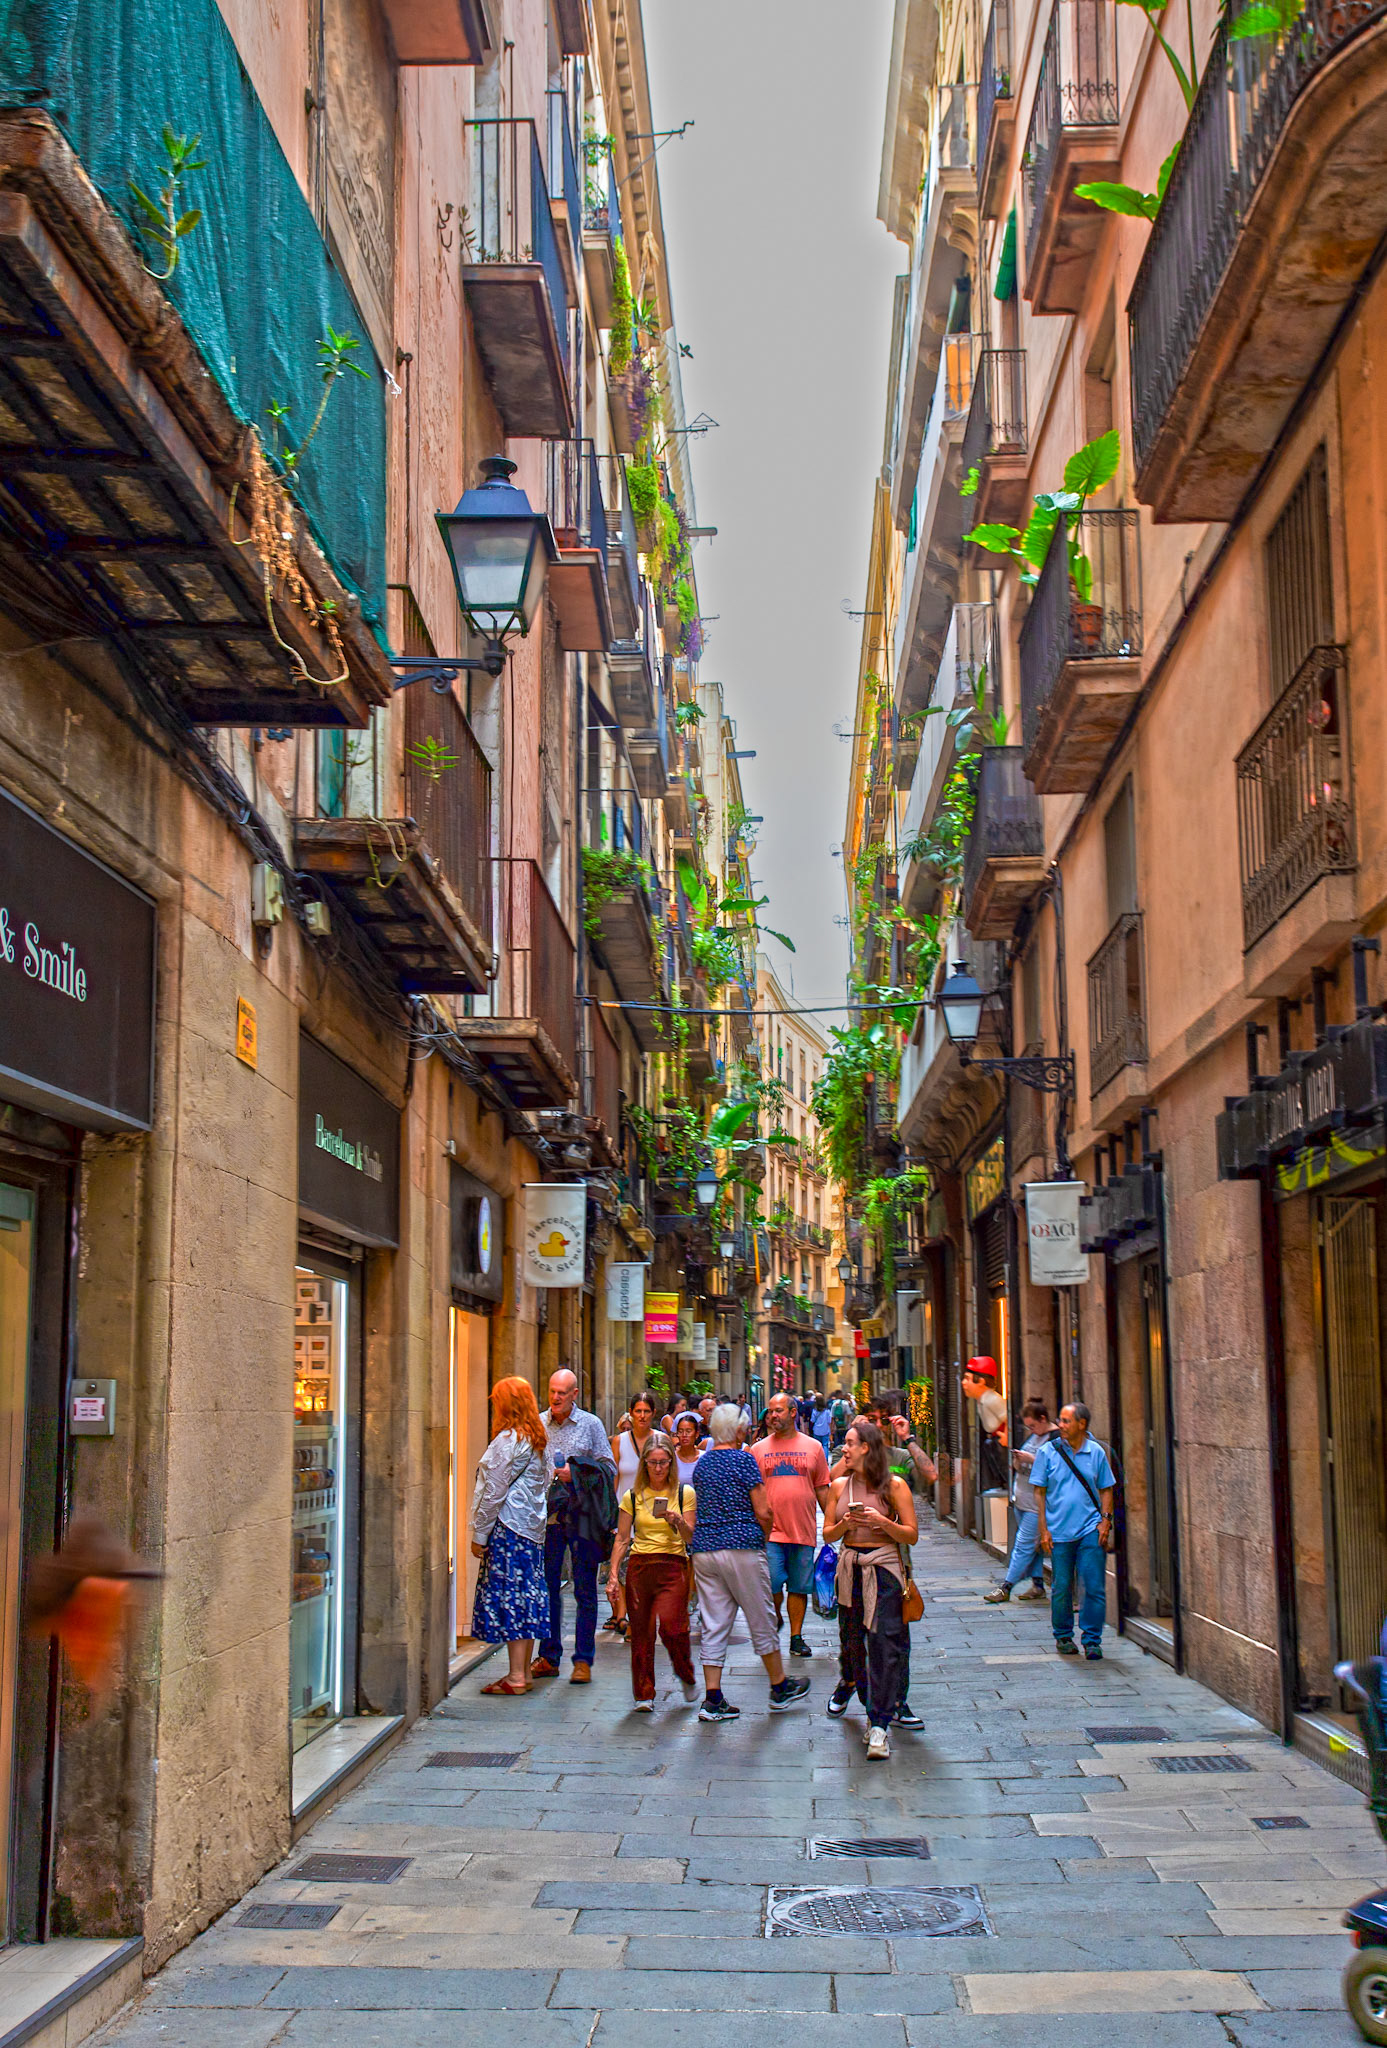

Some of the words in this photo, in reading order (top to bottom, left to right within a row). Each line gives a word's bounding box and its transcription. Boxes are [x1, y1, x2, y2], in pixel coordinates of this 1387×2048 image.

[0, 907, 16, 963] &
[23, 922, 88, 1002] Smile
[315, 1113, 355, 1168] Barcelona
[527, 1216, 582, 1239] Barcelona
[527, 1249, 553, 1272] Duck
[556, 1249, 583, 1273] Store
[790, 1457, 808, 1468] TEAM
